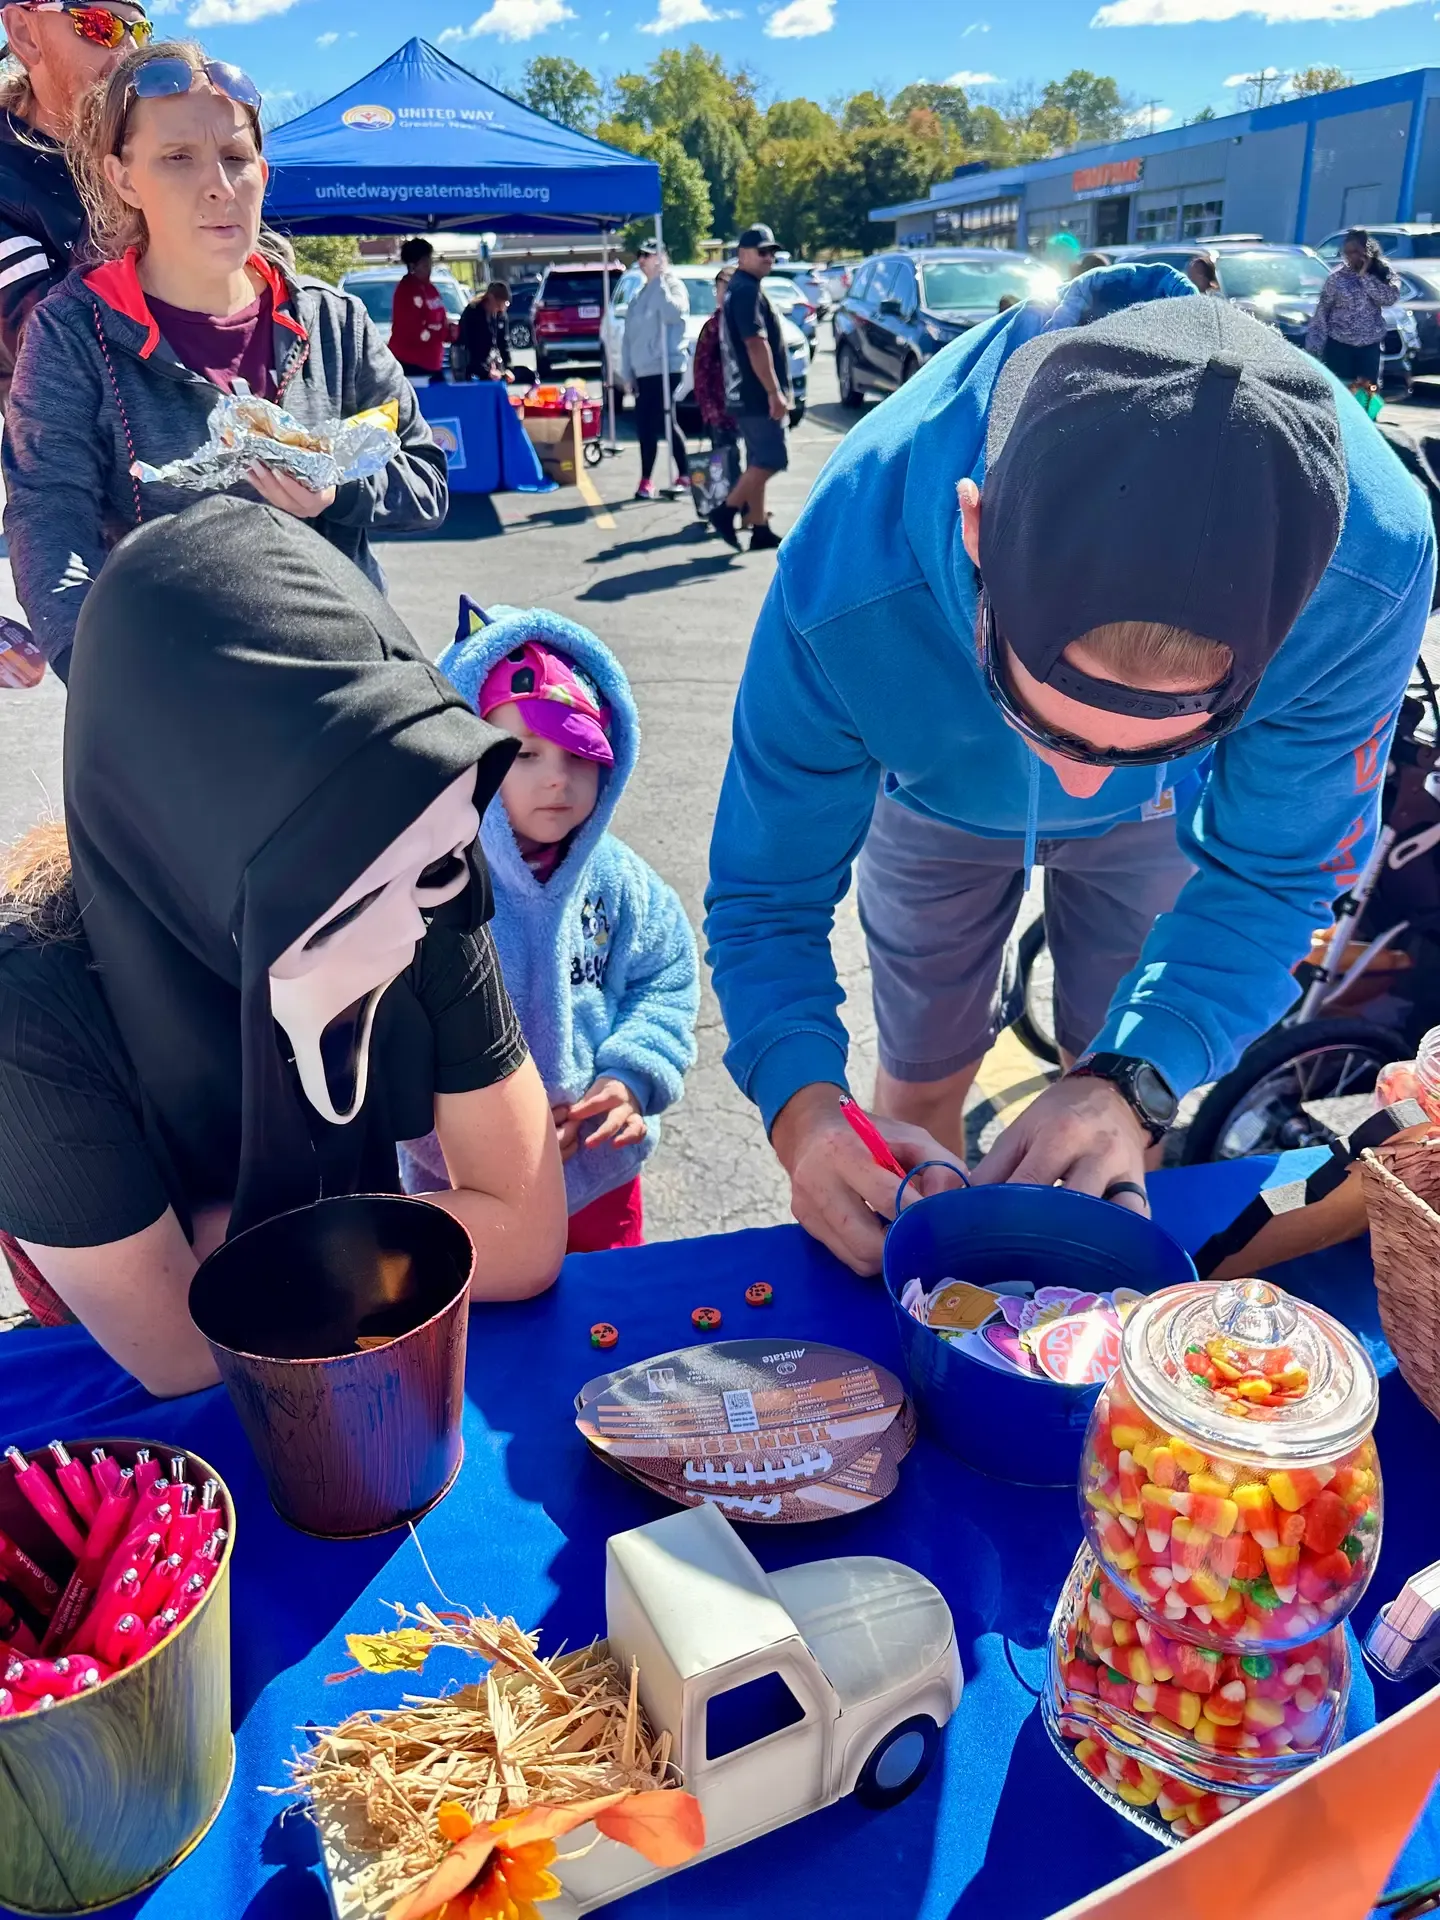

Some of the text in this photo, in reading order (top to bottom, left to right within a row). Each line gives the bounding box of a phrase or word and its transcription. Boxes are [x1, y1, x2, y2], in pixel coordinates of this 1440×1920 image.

[398, 108, 494, 121] UNITED WAY
[315, 182, 550, 202] unitedwaygreaternashville.org
[761, 1347, 806, 1364] Allstate
[16, 1548, 45, 1578] Allstate
